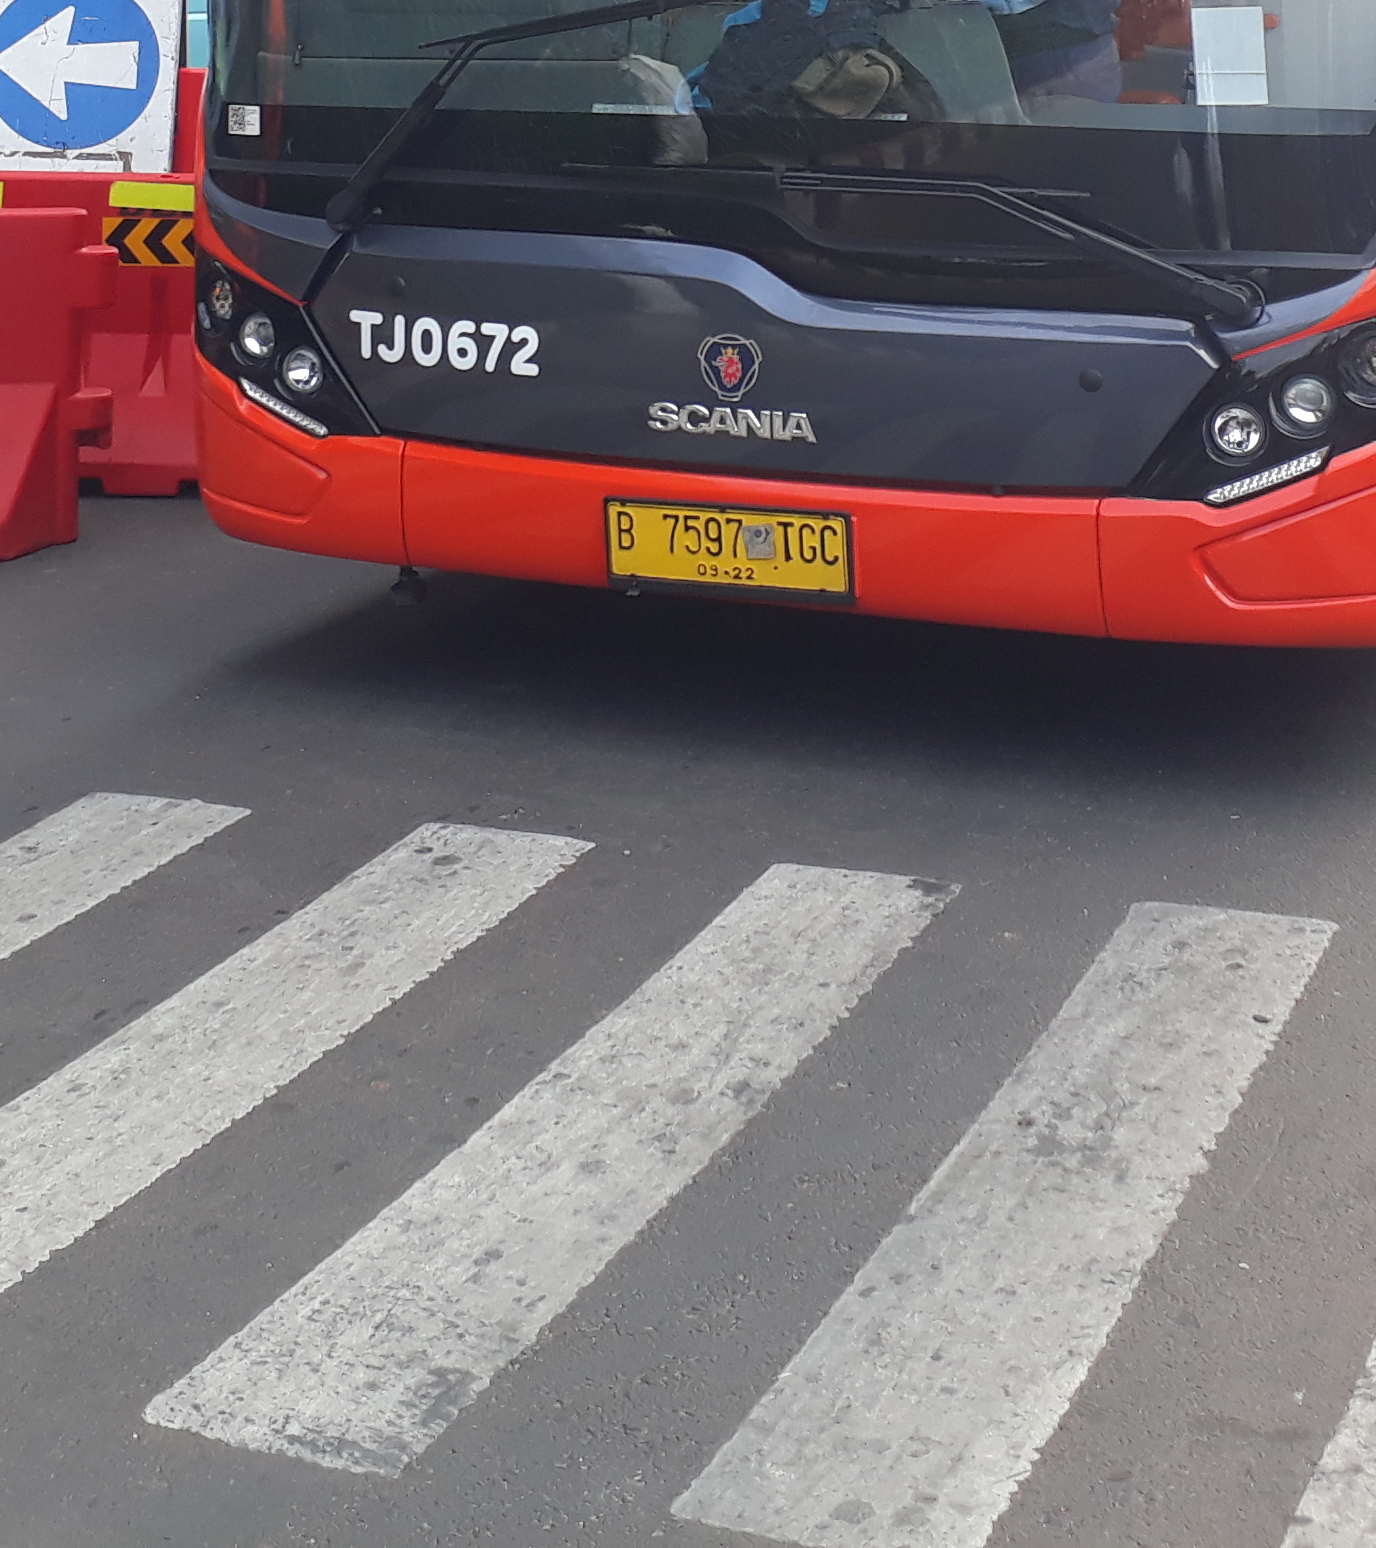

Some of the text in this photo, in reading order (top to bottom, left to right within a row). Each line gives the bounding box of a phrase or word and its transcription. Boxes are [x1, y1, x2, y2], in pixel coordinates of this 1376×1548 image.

[349, 309, 539, 377] TJ0672
[646, 402, 818, 444] SCANIA
[617, 510, 840, 566] B 7597 TGC
